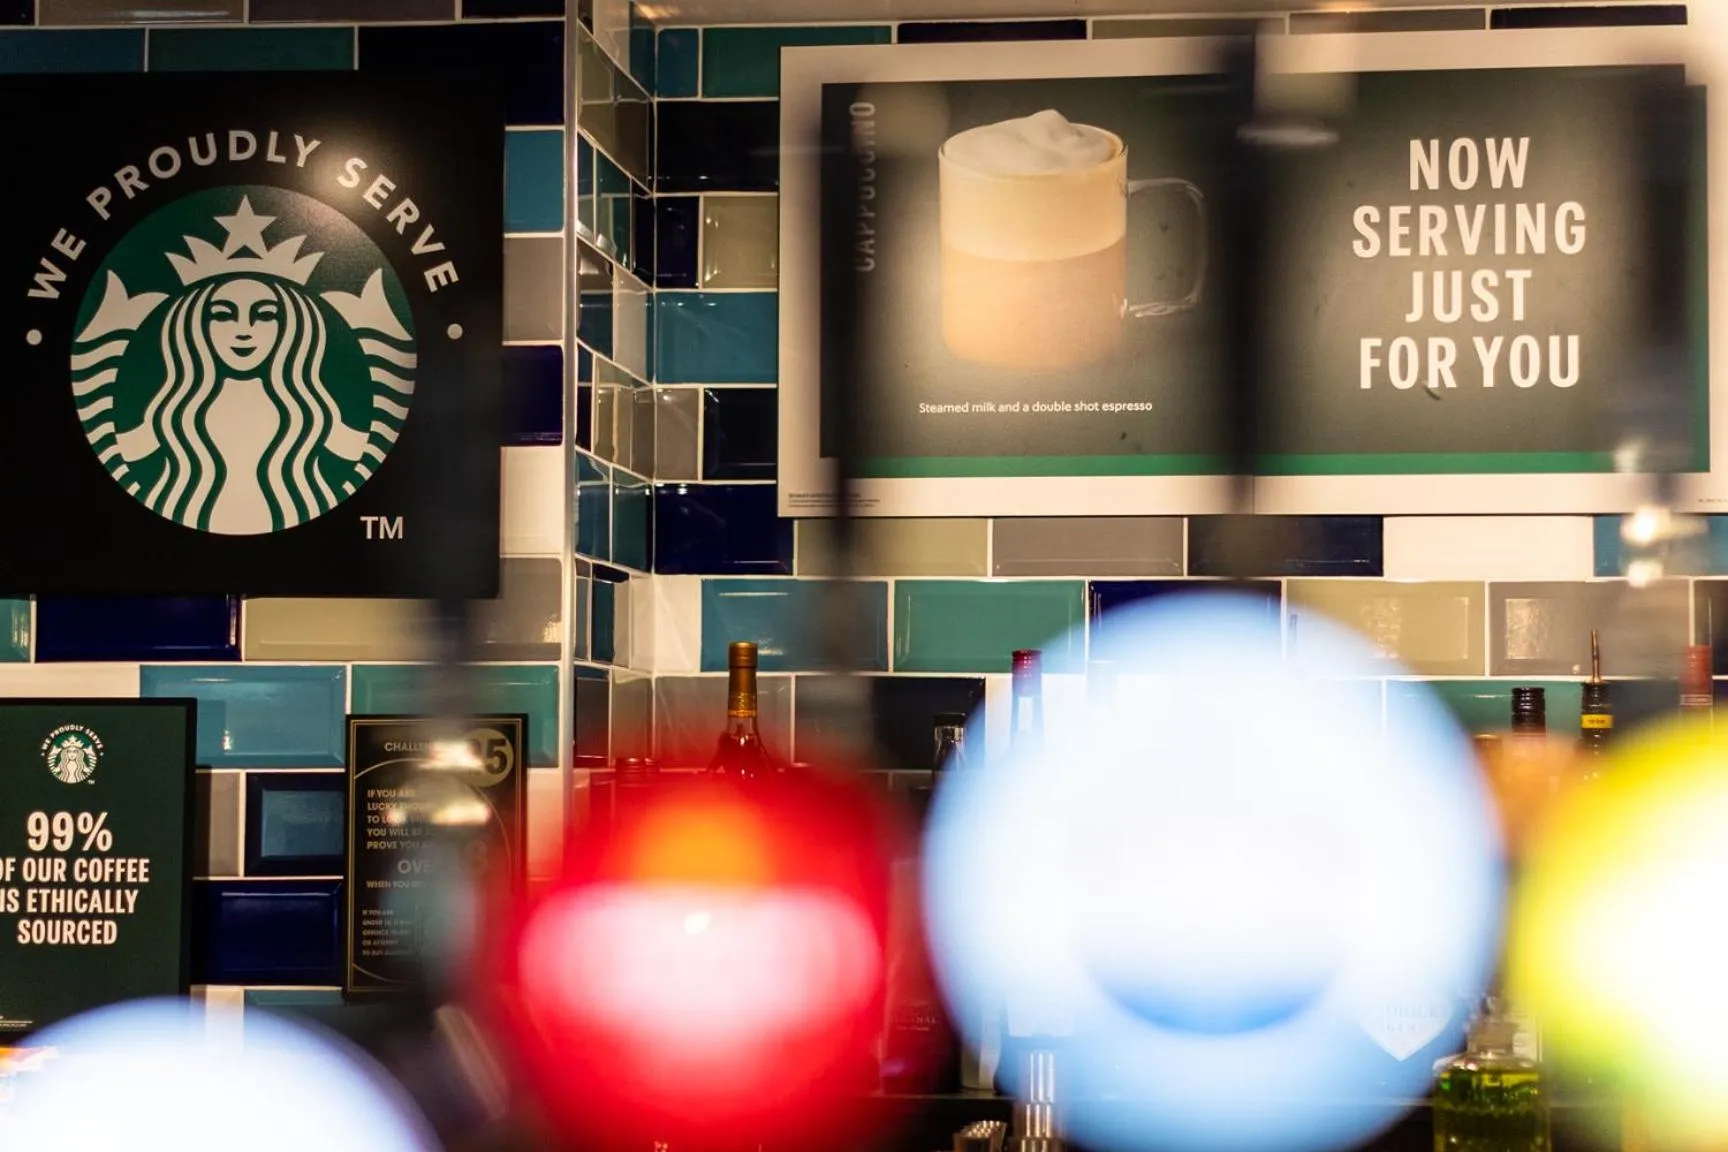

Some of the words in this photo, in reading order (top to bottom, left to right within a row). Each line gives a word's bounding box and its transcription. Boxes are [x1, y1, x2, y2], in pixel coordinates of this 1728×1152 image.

[1408, 136, 1531, 191] NOW
[27, 227, 87, 300] WE
[86, 129, 322, 221] PROUDLY
[336, 156, 460, 294] SERVE
[1351, 201, 1587, 258] SERVING
[1404, 268, 1533, 323] JUST
[1359, 336, 1457, 390] FOR
[1472, 334, 1580, 388] YOU
[918, 402, 970, 414] Steamed
[971, 401, 996, 413] milk
[998, 401, 1020, 413] and
[1022, 403, 1030, 413] a
[1031, 400, 1072, 412] double
[1073, 400, 1100, 412] shot
[1101, 401, 1153, 414] espresso
[359, 515, 404, 540] TM
[384, 741, 436, 752] CHALLE
[366, 789, 375, 798] IF
[375, 789, 397, 798] YOU
[27, 811, 113, 852] 99%
[366, 815, 380, 824] TO
[366, 828, 387, 837] YOU
[366, 841, 397, 850] PROVE
[0, 857, 16, 882] F
[22, 857, 67, 882] OUR
[73, 857, 150, 883] COFFEE
[397, 859, 434, 875] OVE
[0, 888, 20, 913] IS
[26, 888, 139, 914] ETHICALLY
[17, 919, 118, 945] SOURCED
